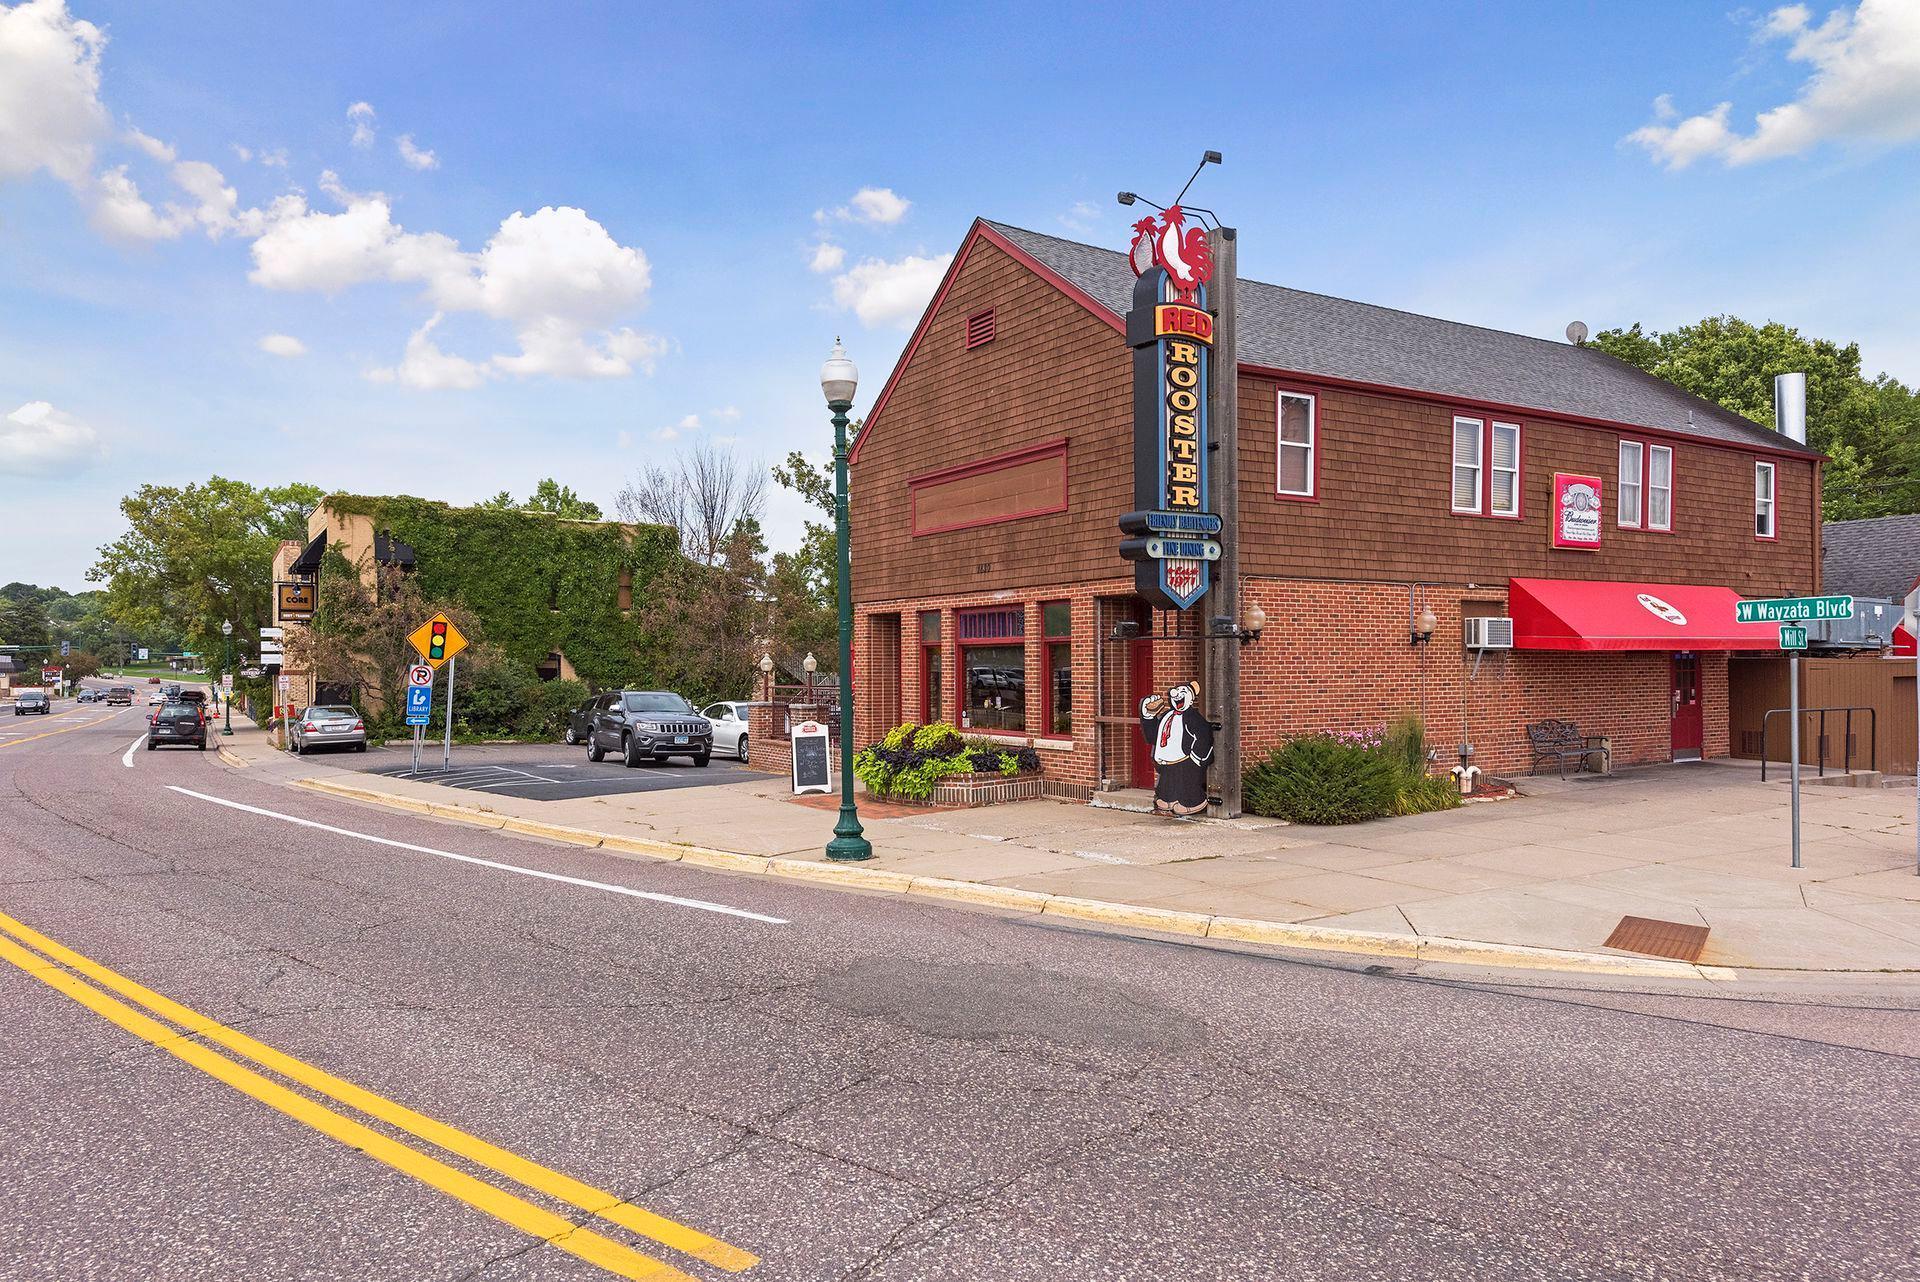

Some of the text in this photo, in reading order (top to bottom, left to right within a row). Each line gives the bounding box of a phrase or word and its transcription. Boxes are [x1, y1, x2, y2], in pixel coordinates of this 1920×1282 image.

[1162, 307, 1212, 337] RED
[1168, 341, 1200, 507] ROOSTER
[1564, 510, 1597, 524] Budweiser
[1169, 576, 1196, 587] 1971
[1742, 600, 1847, 620] W Wayzata Blvd
[1784, 629, 1804, 646] Mill St
